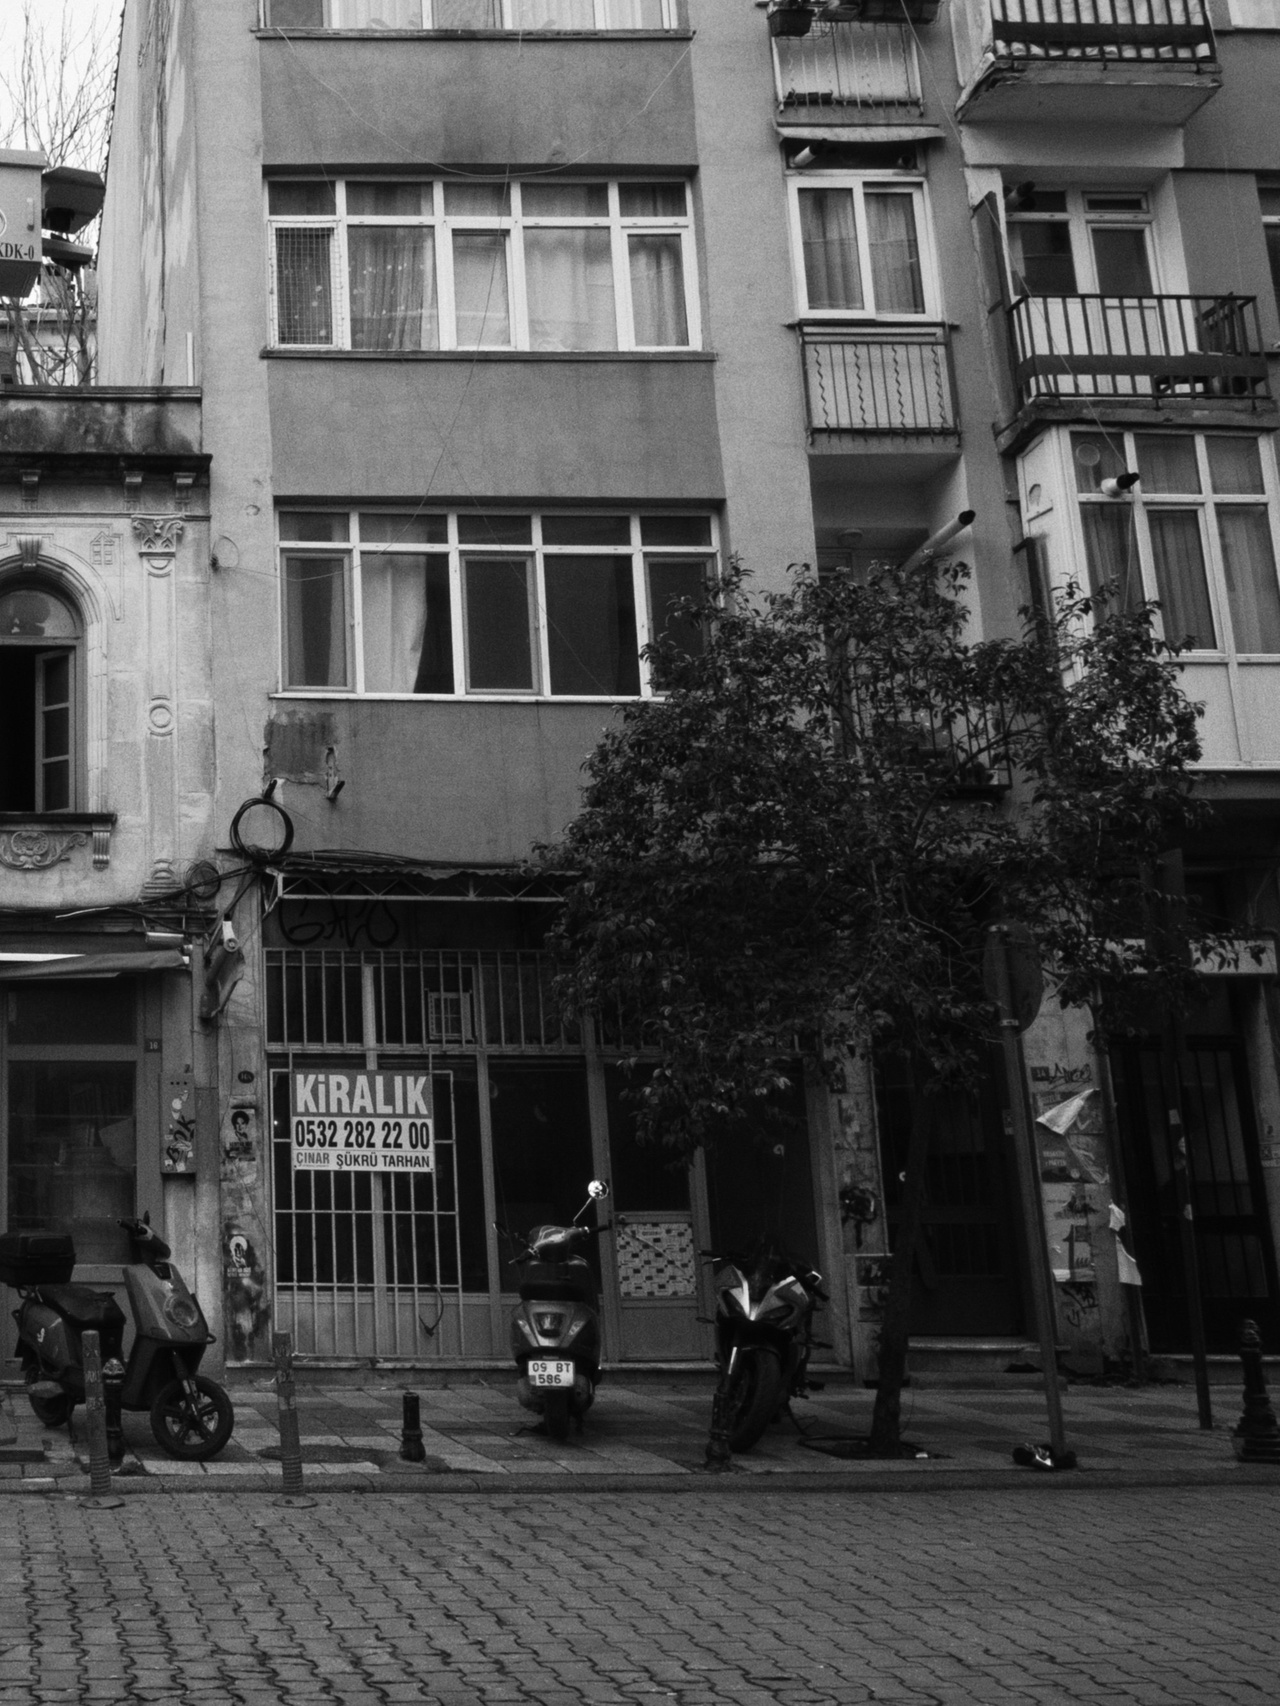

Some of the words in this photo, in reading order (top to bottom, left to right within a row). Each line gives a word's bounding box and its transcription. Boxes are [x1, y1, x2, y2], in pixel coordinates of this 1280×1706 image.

[295, 1120, 337, 1147] 0532
[344, 1121, 375, 1148] 282
[382, 1121, 402, 1148] 22
[409, 1122, 429, 1149] 00
[296, 1152, 330, 1167] ÇINAR
[336, 1151, 378, 1169] ŞÜKRÜ
[382, 1154, 430, 1169] TARHAN
[532, 1362, 547, 1373] 09
[556, 1362, 571, 1373] BT
